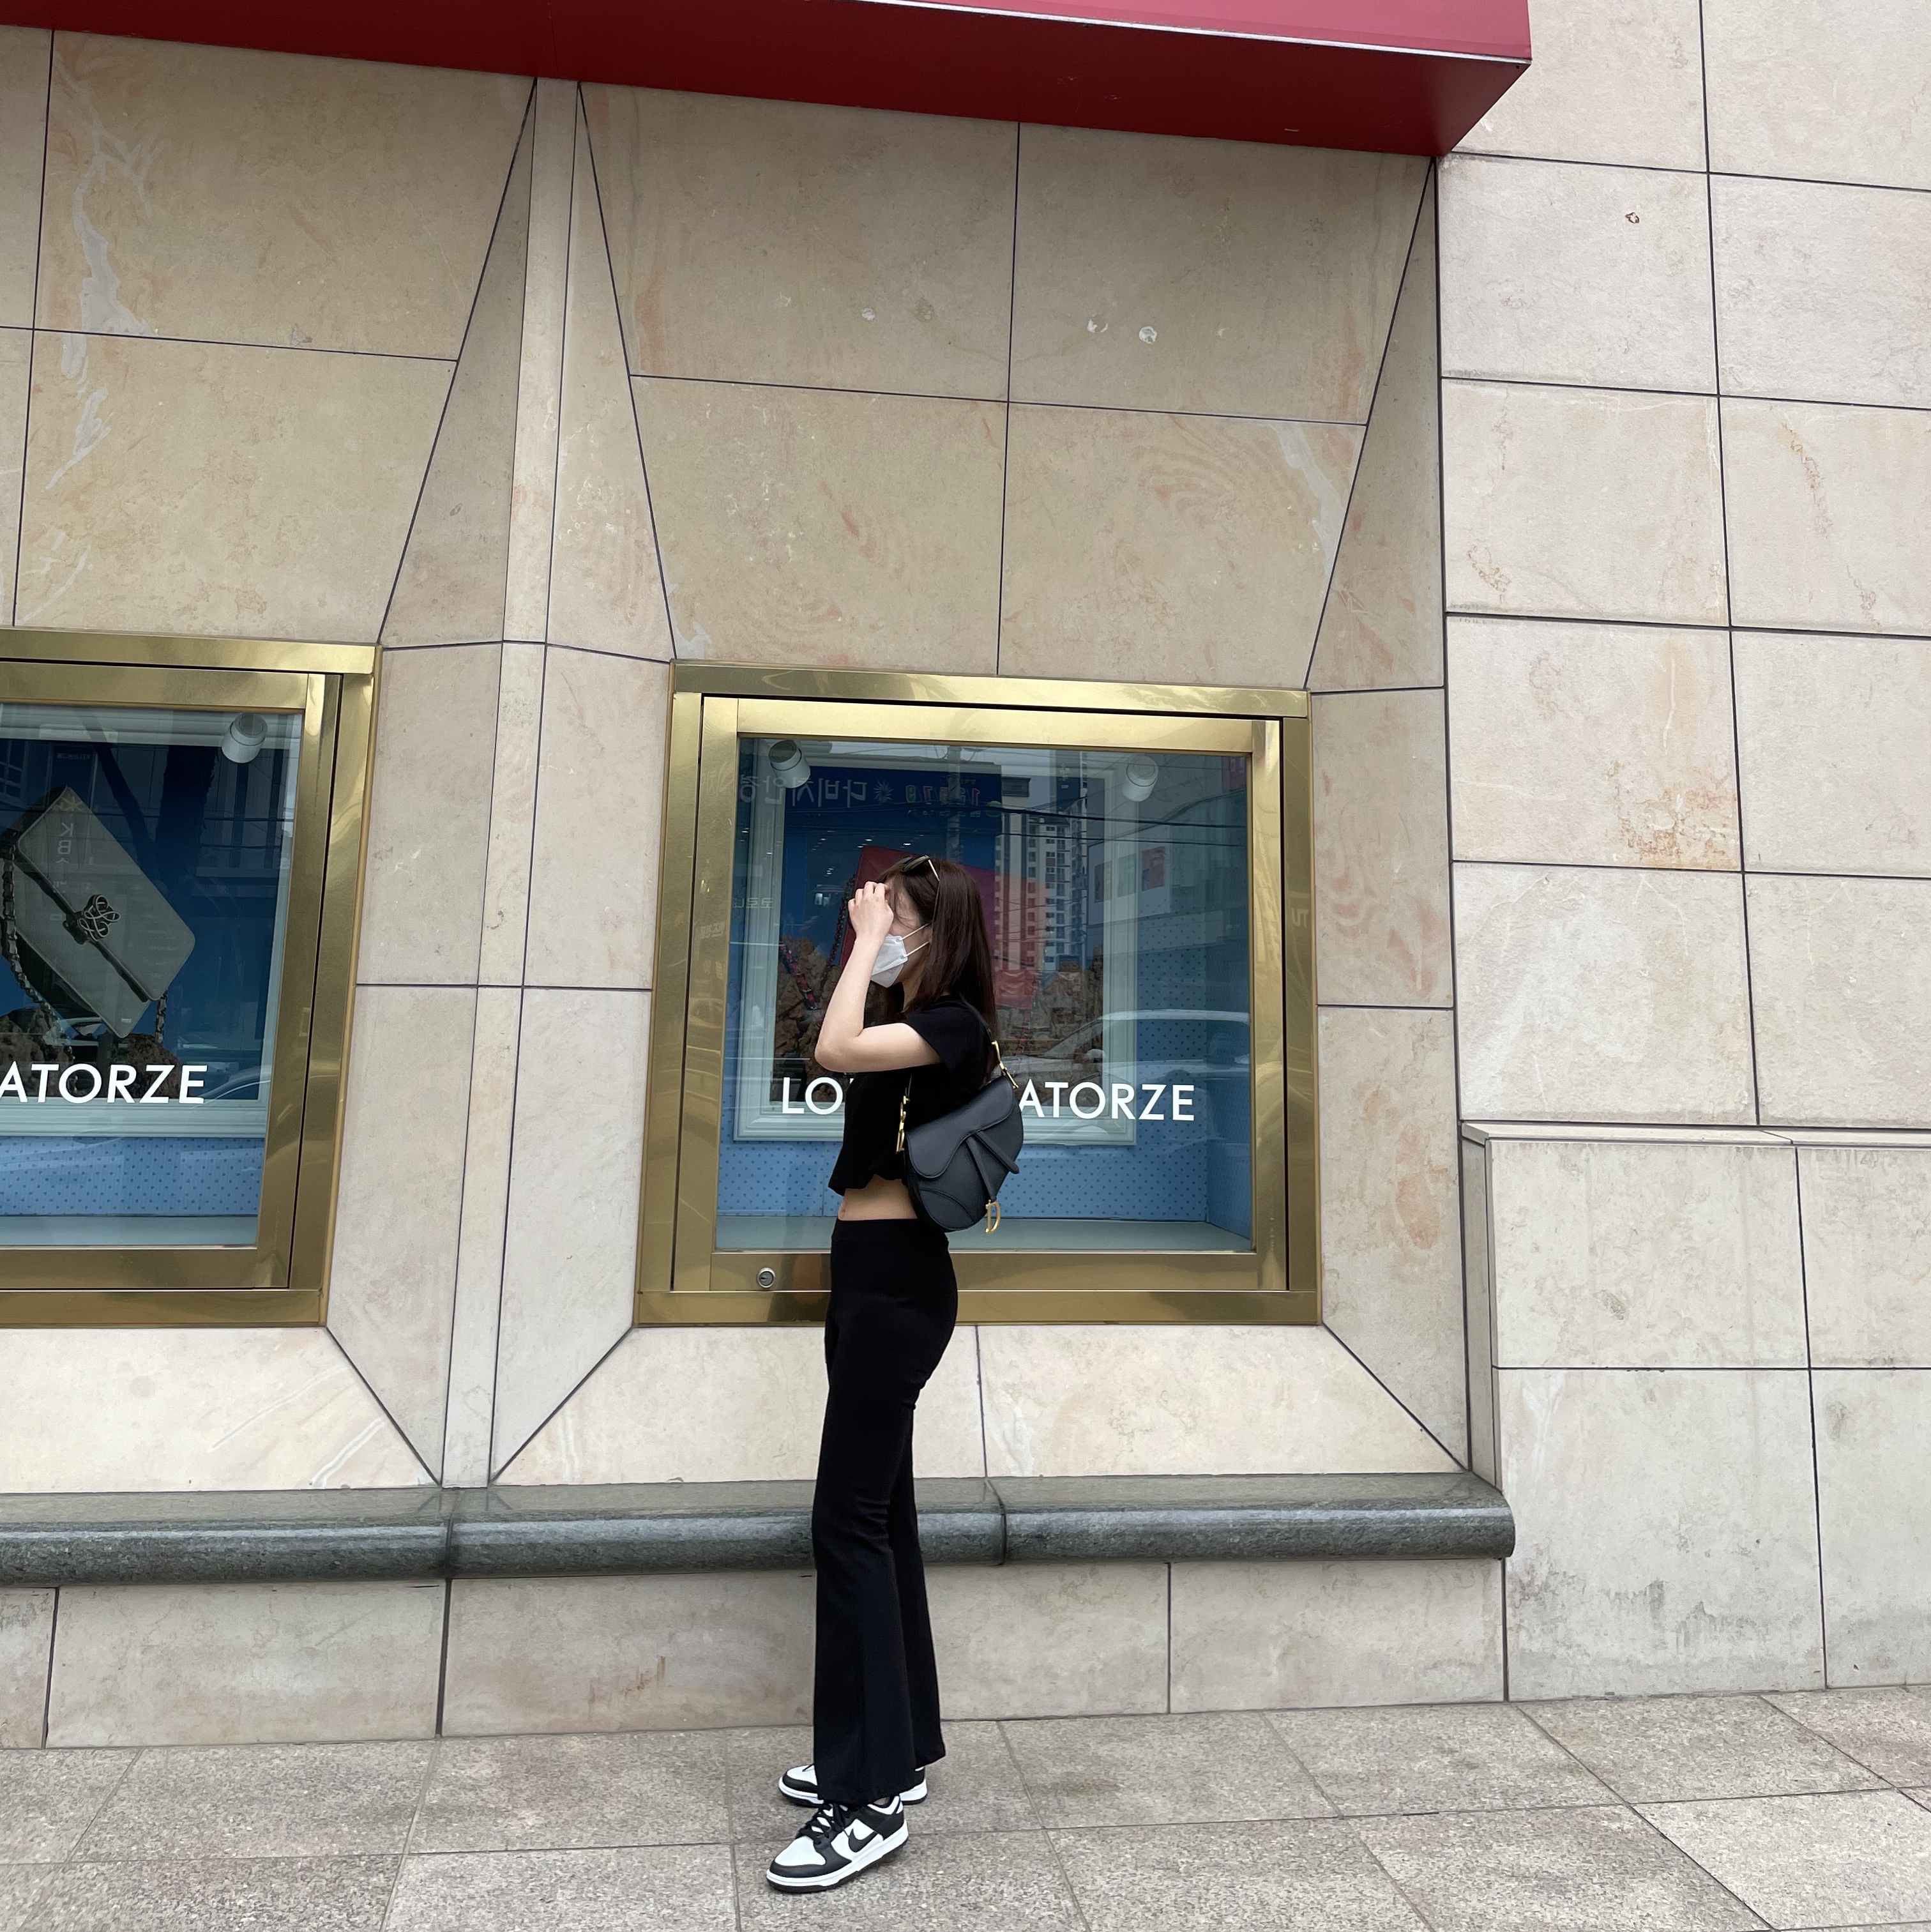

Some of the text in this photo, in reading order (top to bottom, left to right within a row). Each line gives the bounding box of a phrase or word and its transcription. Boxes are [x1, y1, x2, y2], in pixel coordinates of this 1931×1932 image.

[0, 1061, 208, 1104] ATORZE
[782, 1077, 1195, 1121] LO ATORZE
